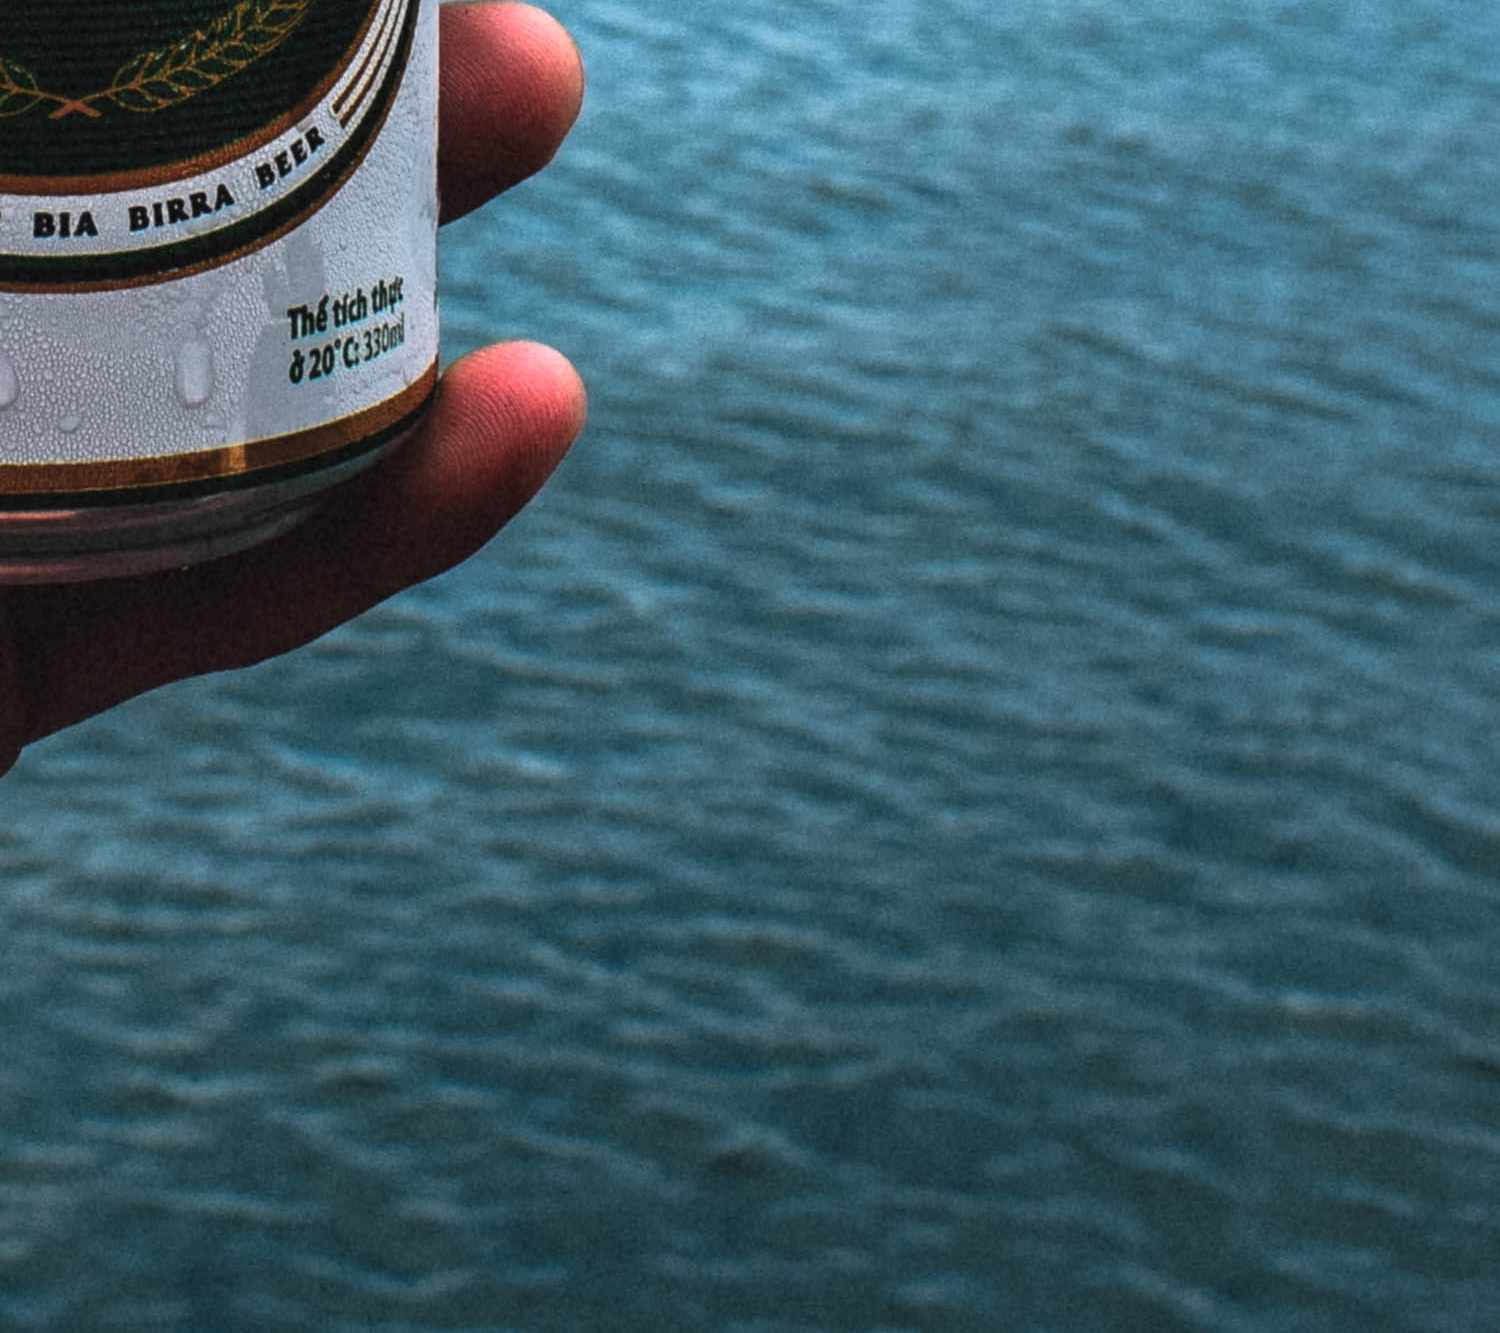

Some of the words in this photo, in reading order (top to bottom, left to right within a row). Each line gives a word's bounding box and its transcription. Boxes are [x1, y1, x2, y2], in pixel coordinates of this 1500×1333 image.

[33, 210, 98, 237] BIA
[128, 183, 235, 232] BIRRA
[255, 126, 326, 190] BEER
